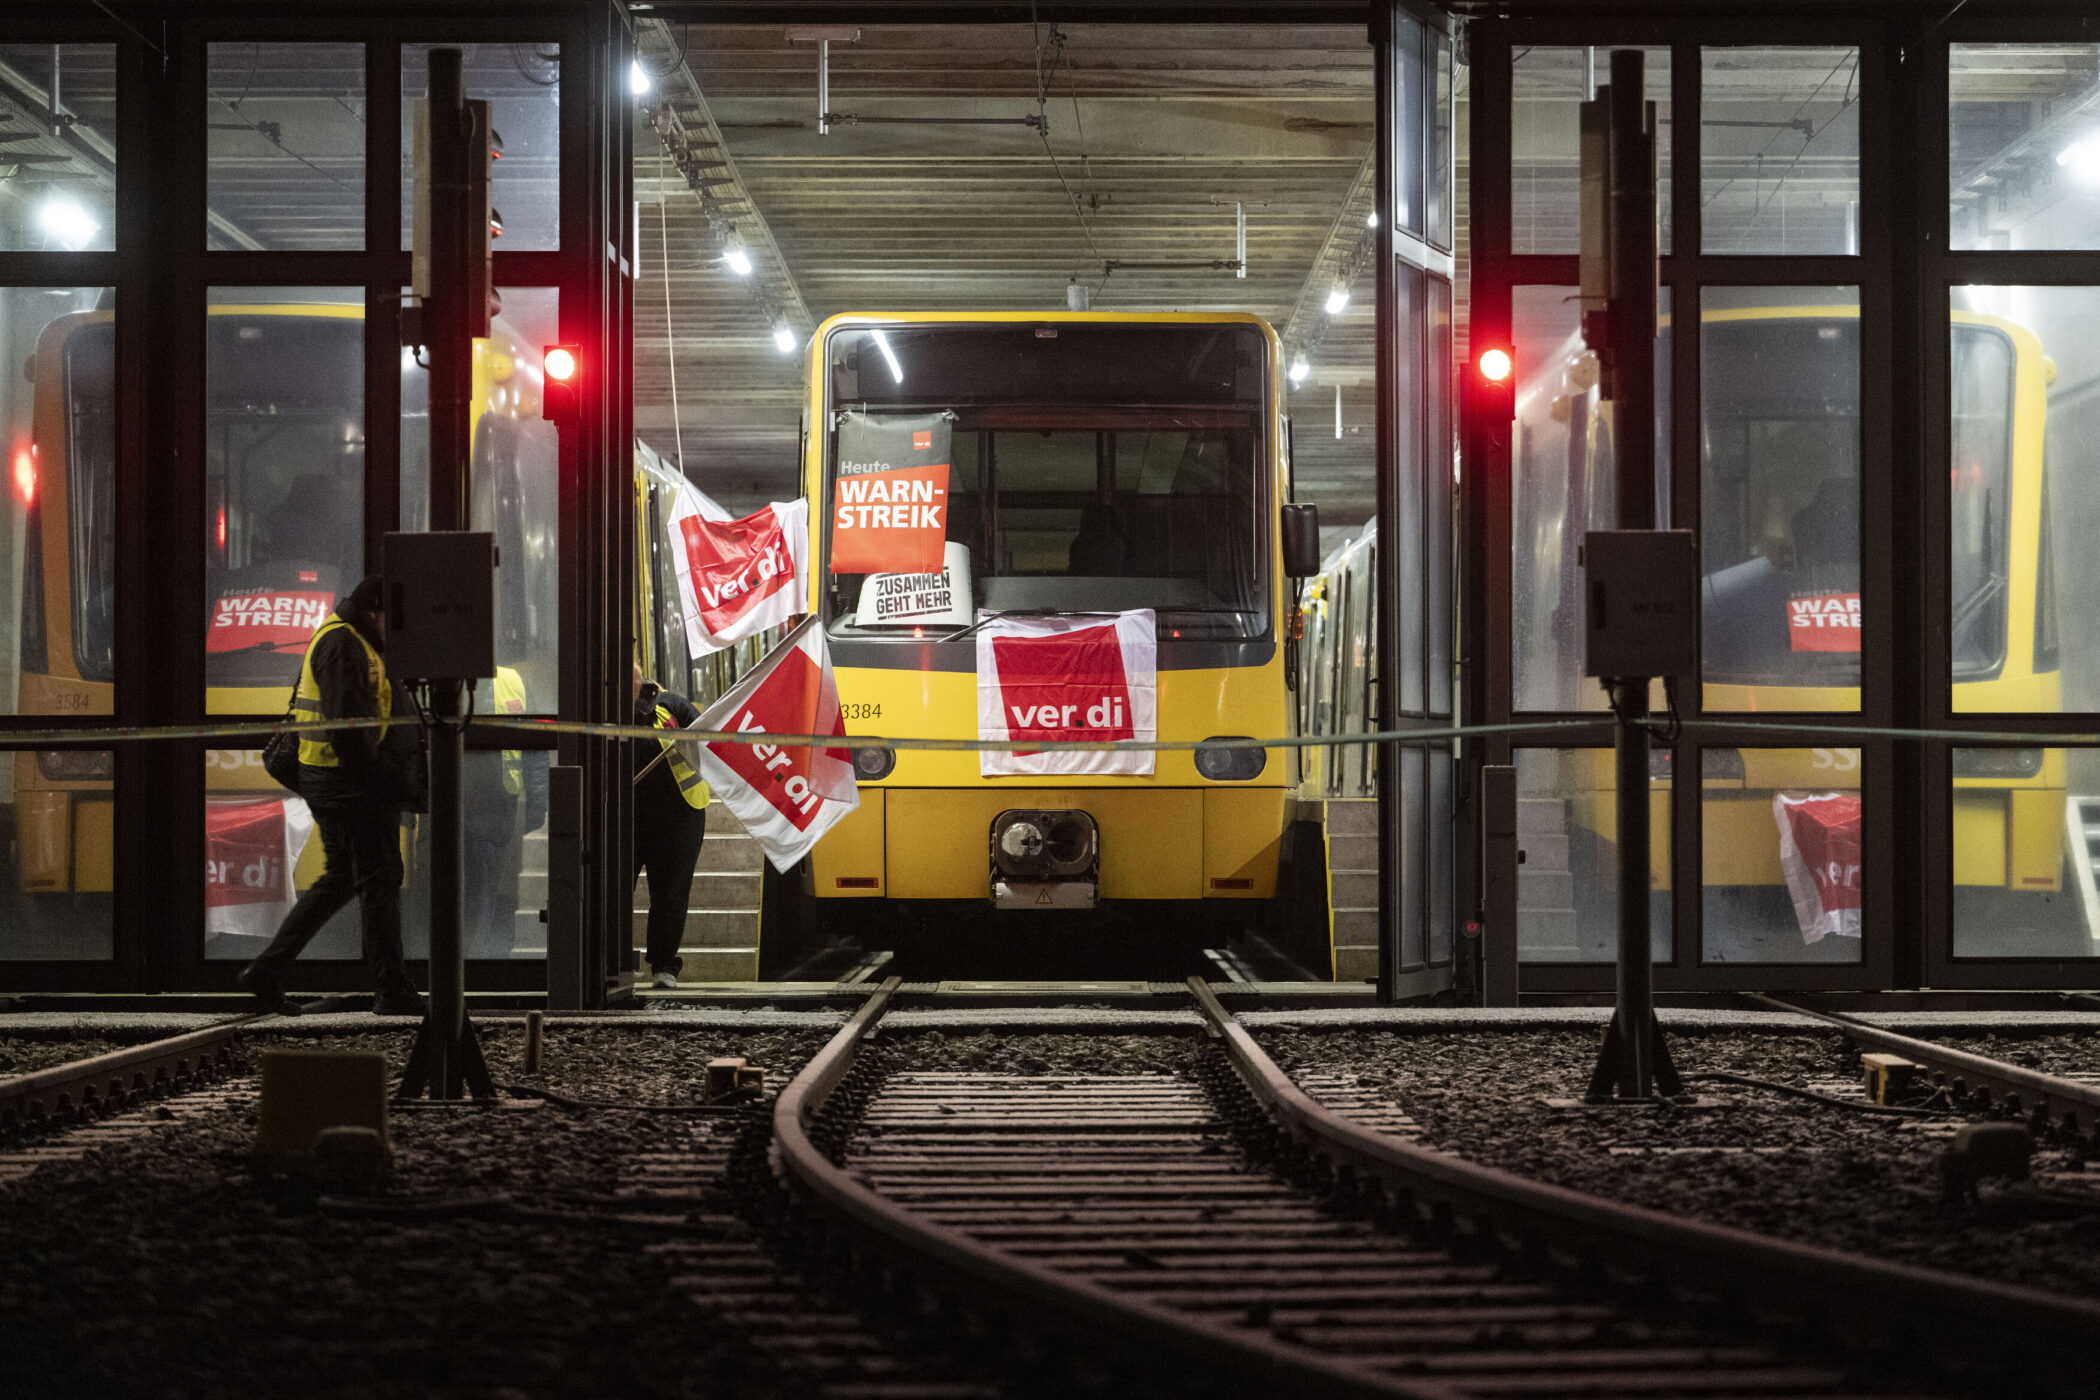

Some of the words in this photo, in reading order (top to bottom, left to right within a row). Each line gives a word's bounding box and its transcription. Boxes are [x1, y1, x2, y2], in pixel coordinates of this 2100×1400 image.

[841, 460, 890, 474] Heute
[840, 480, 944, 503] WARN-
[838, 505, 942, 529] STREIK
[700, 541, 786, 607] ver.di
[876, 572, 951, 597] ZUSAMMEN
[877, 595, 911, 615] GEHT
[915, 590, 952, 609] MEHR
[215, 612, 322, 628] STREIK
[841, 703, 882, 720] 3384
[1011, 696, 1123, 728] ver.di
